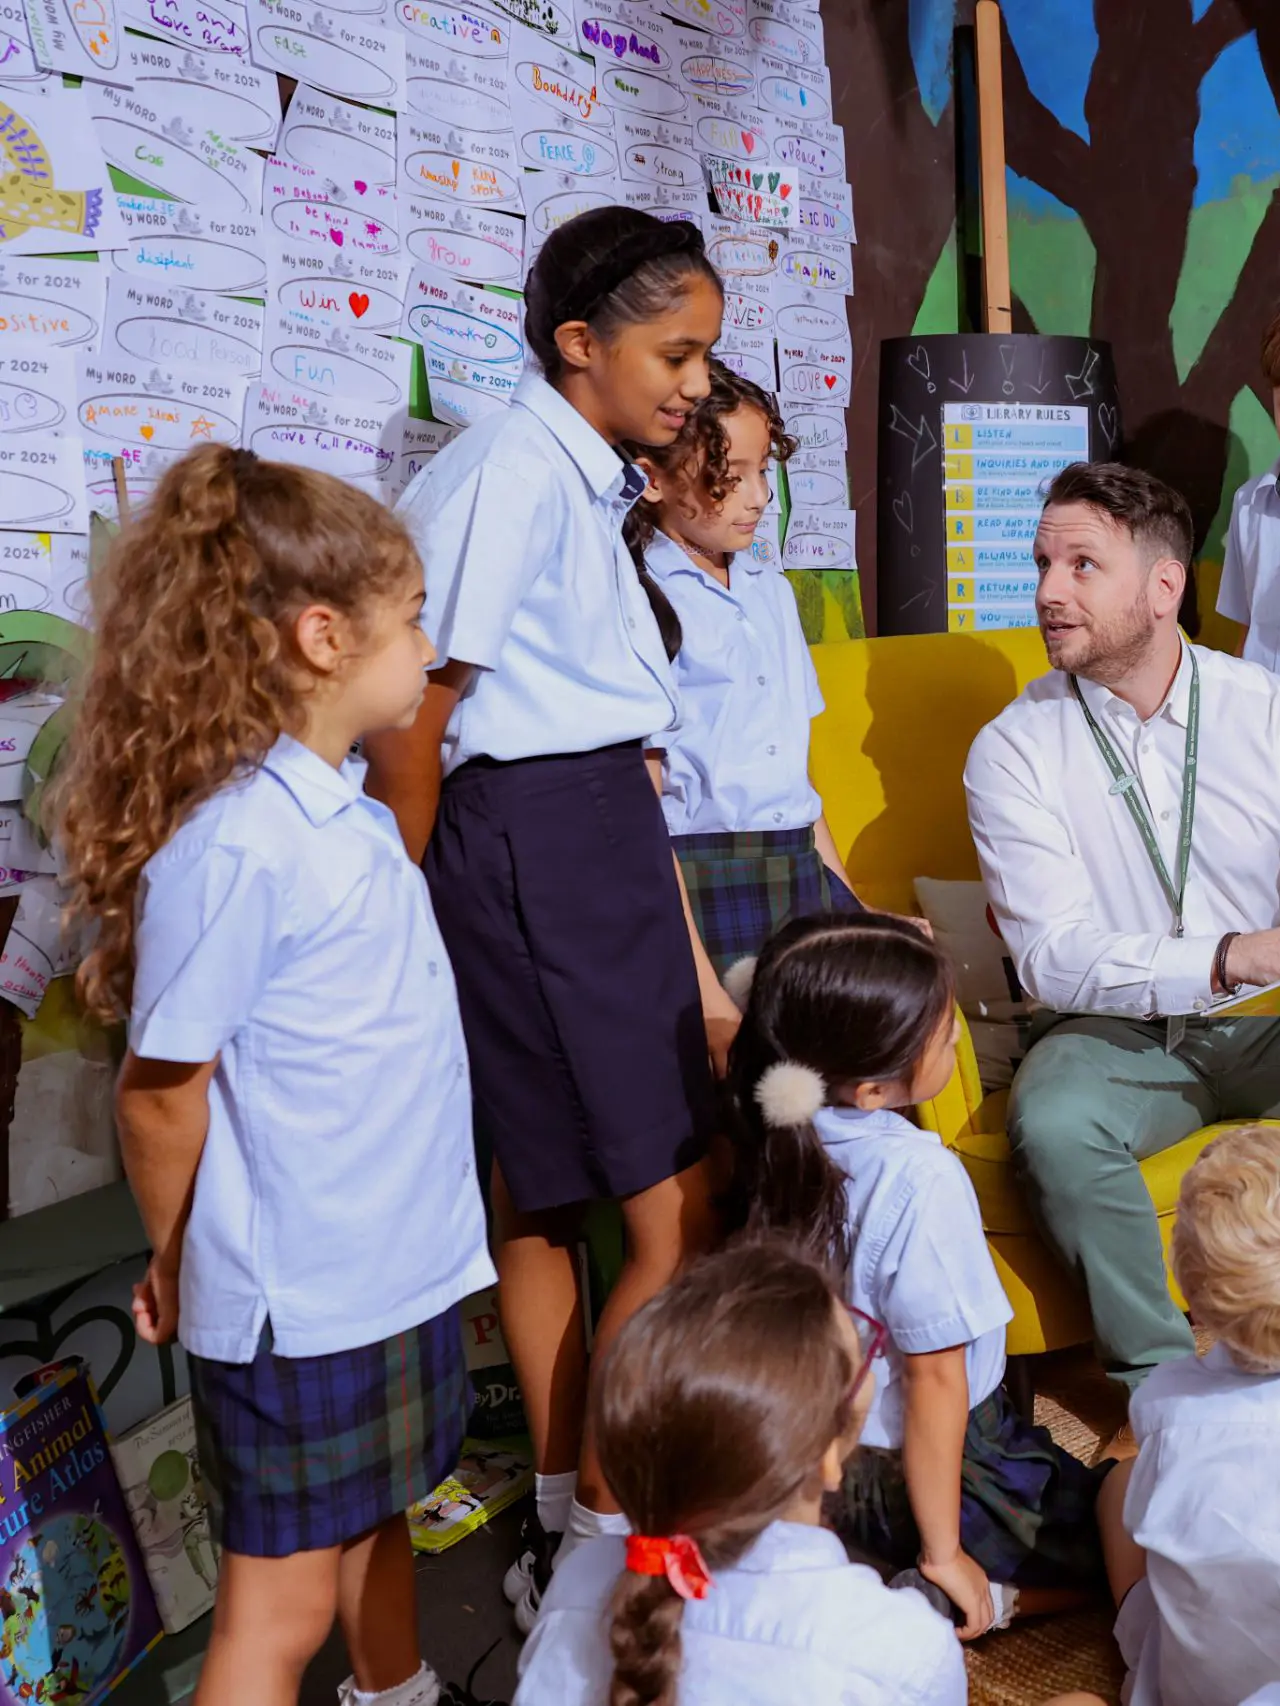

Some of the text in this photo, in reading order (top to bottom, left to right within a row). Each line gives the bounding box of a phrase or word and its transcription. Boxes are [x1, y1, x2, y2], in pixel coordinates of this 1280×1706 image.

[103, 87, 120, 107] My
[125, 97, 157, 122] WORD
[410, 127, 509, 159] My WORD for 2024
[410, 205, 513, 238] My WORD for 2024
[18, 274, 82, 289] for 2024
[127, 288, 261, 330] My WORD for 2024
[419, 281, 518, 322] My WORD for 2024
[0, 313, 69, 333] ositive
[86, 367, 231, 399] My WORD for 2024
[472, 372, 486, 381] for
[489, 376, 512, 388] 2024
[987, 408, 1071, 421] LIBRARY RULES
[977, 429, 1012, 439] LISTEN
[977, 459, 1049, 468] INQUIRIES AND
[977, 487, 989, 496] BE
[1015, 488, 1031, 496] AND
[977, 519, 1023, 528] READ AND
[1002, 530, 1036, 538] LIBRAR
[4, 547, 40, 561] 2024
[978, 551, 1018, 561] ALWAYS
[980, 583, 1019, 592] RETURN
[980, 613, 1000, 623] YOU
[488, 1382, 523, 1406] Dr.
[0, 1397, 72, 1461] INGFISHER
[14, 1405, 93, 1493] Animal
[50, 1441, 104, 1500] Atlas
